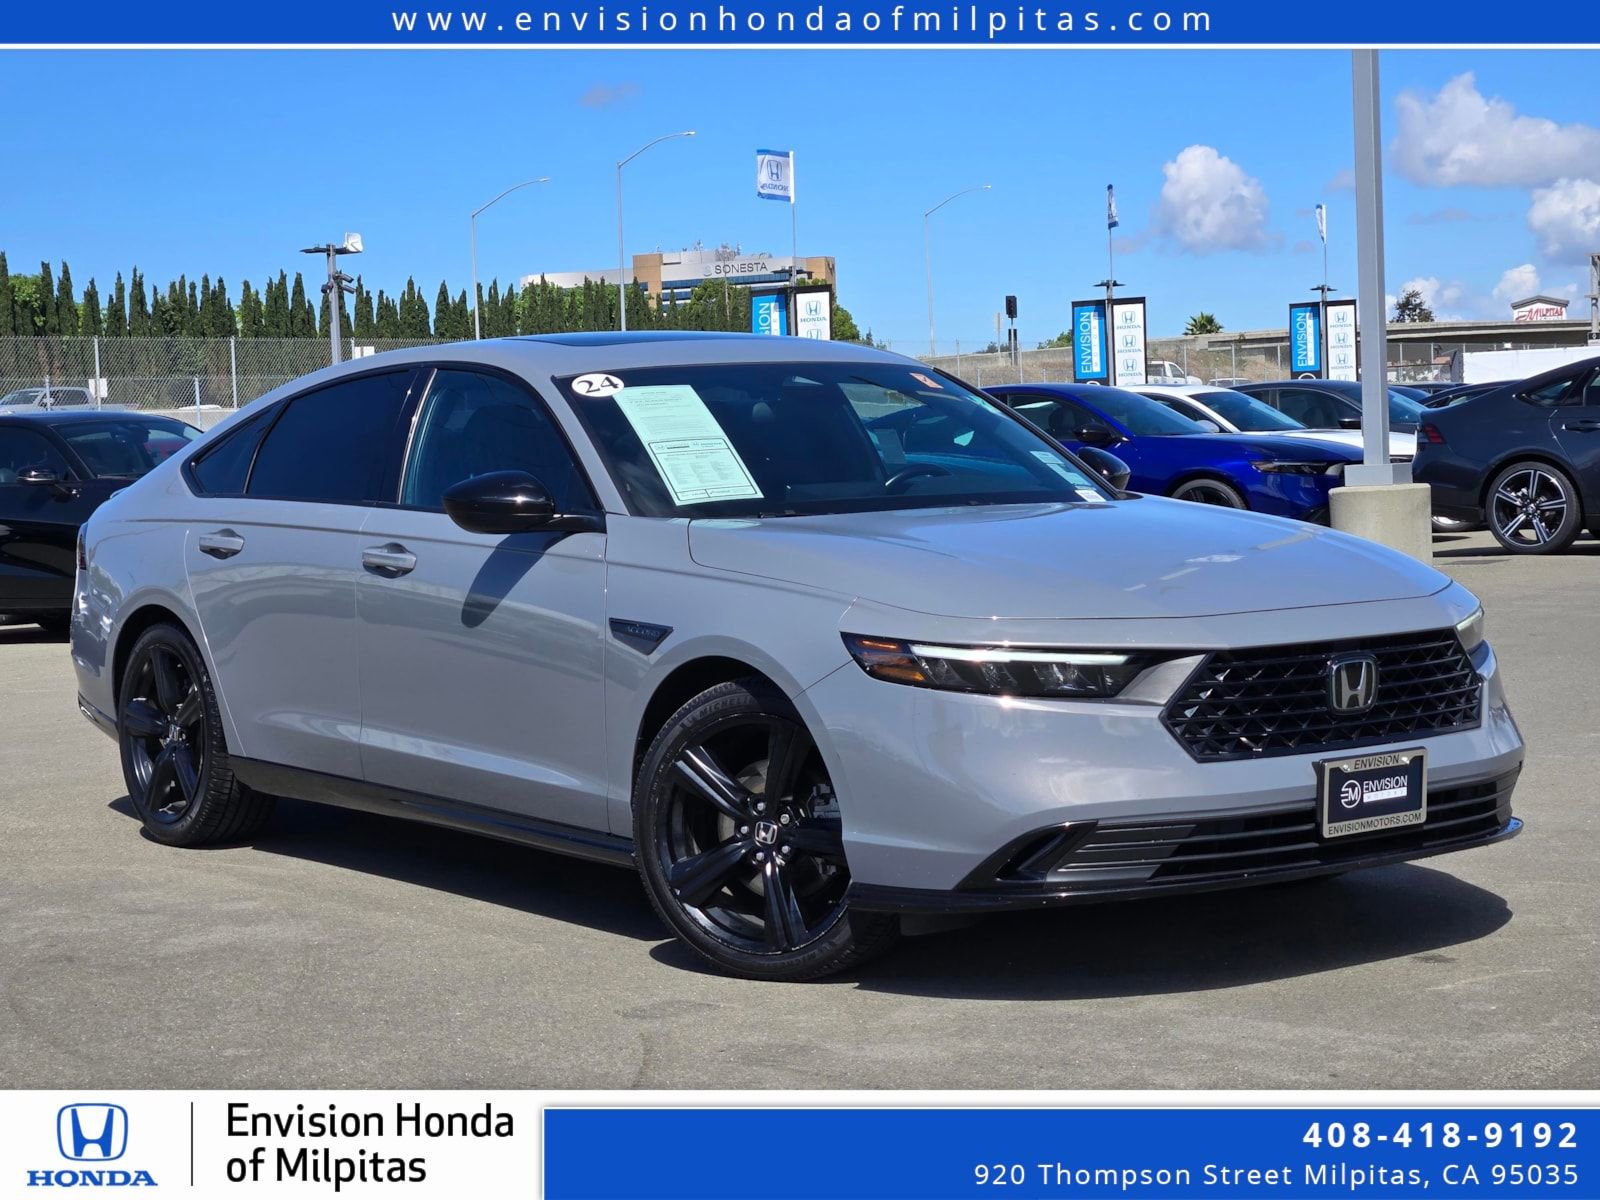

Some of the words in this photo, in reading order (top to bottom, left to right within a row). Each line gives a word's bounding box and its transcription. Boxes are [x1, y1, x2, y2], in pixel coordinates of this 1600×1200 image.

[714, 262, 768, 275] SONESTA
[1080, 312, 1092, 373] ENVISION
[1296, 312, 1307, 367] ENVISION
[577, 376, 620, 394] 24
[1354, 754, 1400, 770] ENVISION
[1363, 775, 1408, 793] ENVISION
[1328, 813, 1422, 836] ENVISIONMOTORS.COM
